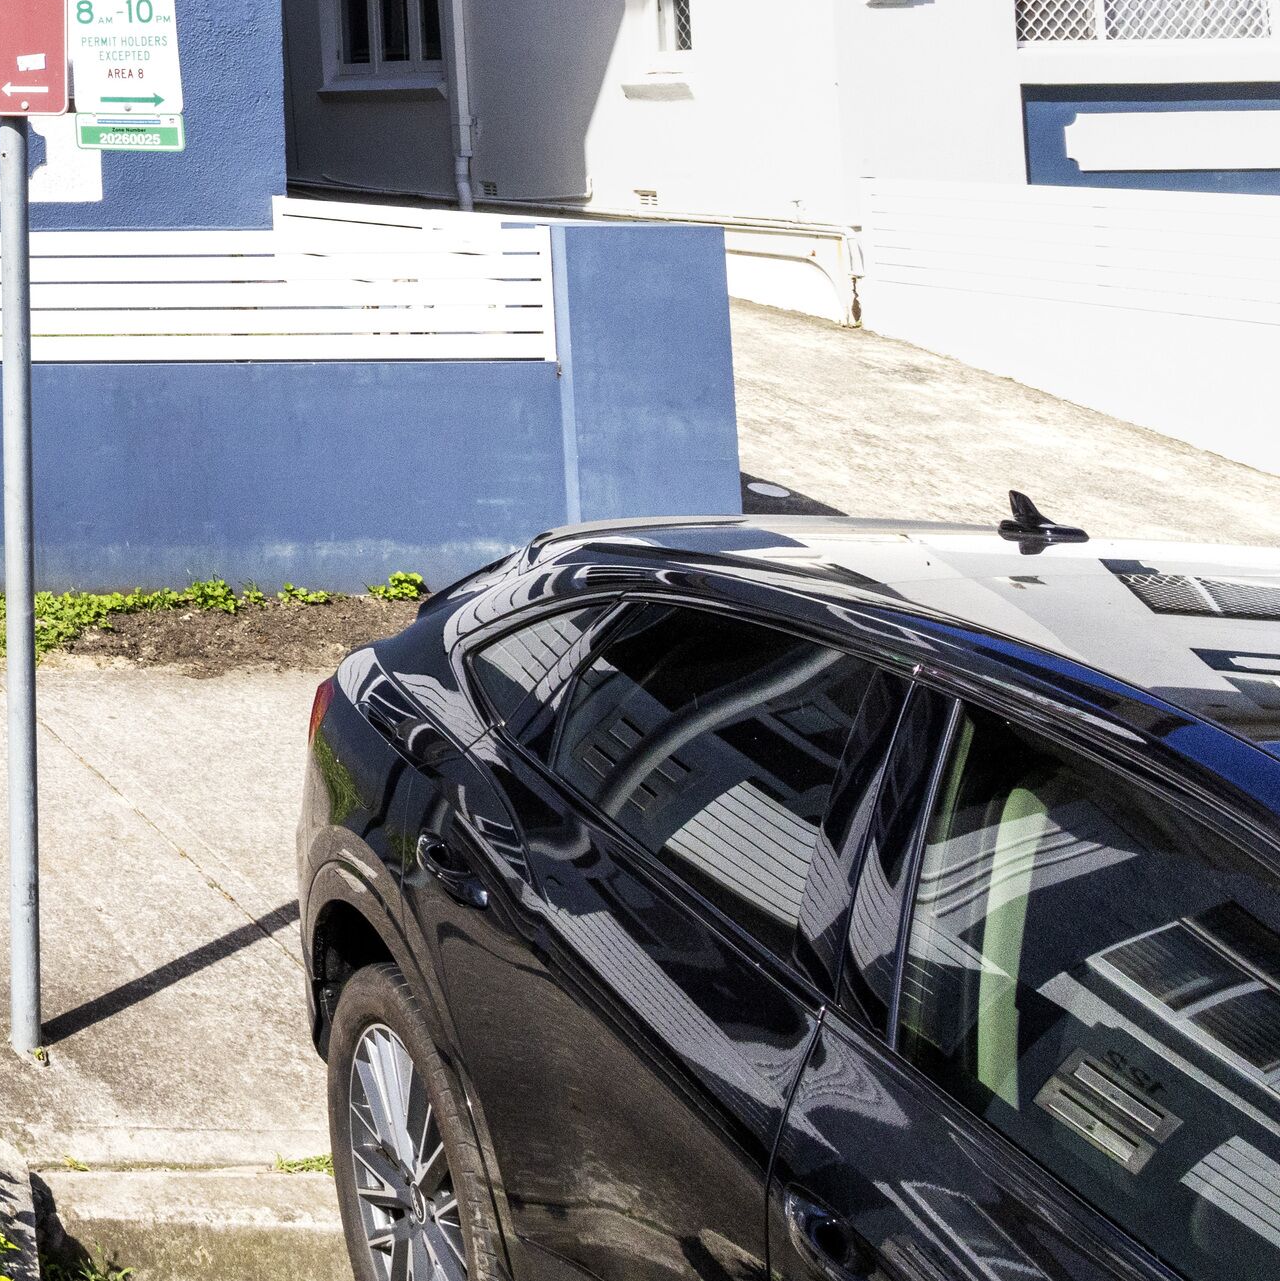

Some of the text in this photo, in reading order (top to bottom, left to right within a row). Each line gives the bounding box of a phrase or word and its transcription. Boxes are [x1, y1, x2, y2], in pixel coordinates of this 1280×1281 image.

[81, 35, 168, 47] PERMIT HOLDERS
[99, 50, 151, 61] EXCEPTED
[107, 68, 145, 79] AREA 8
